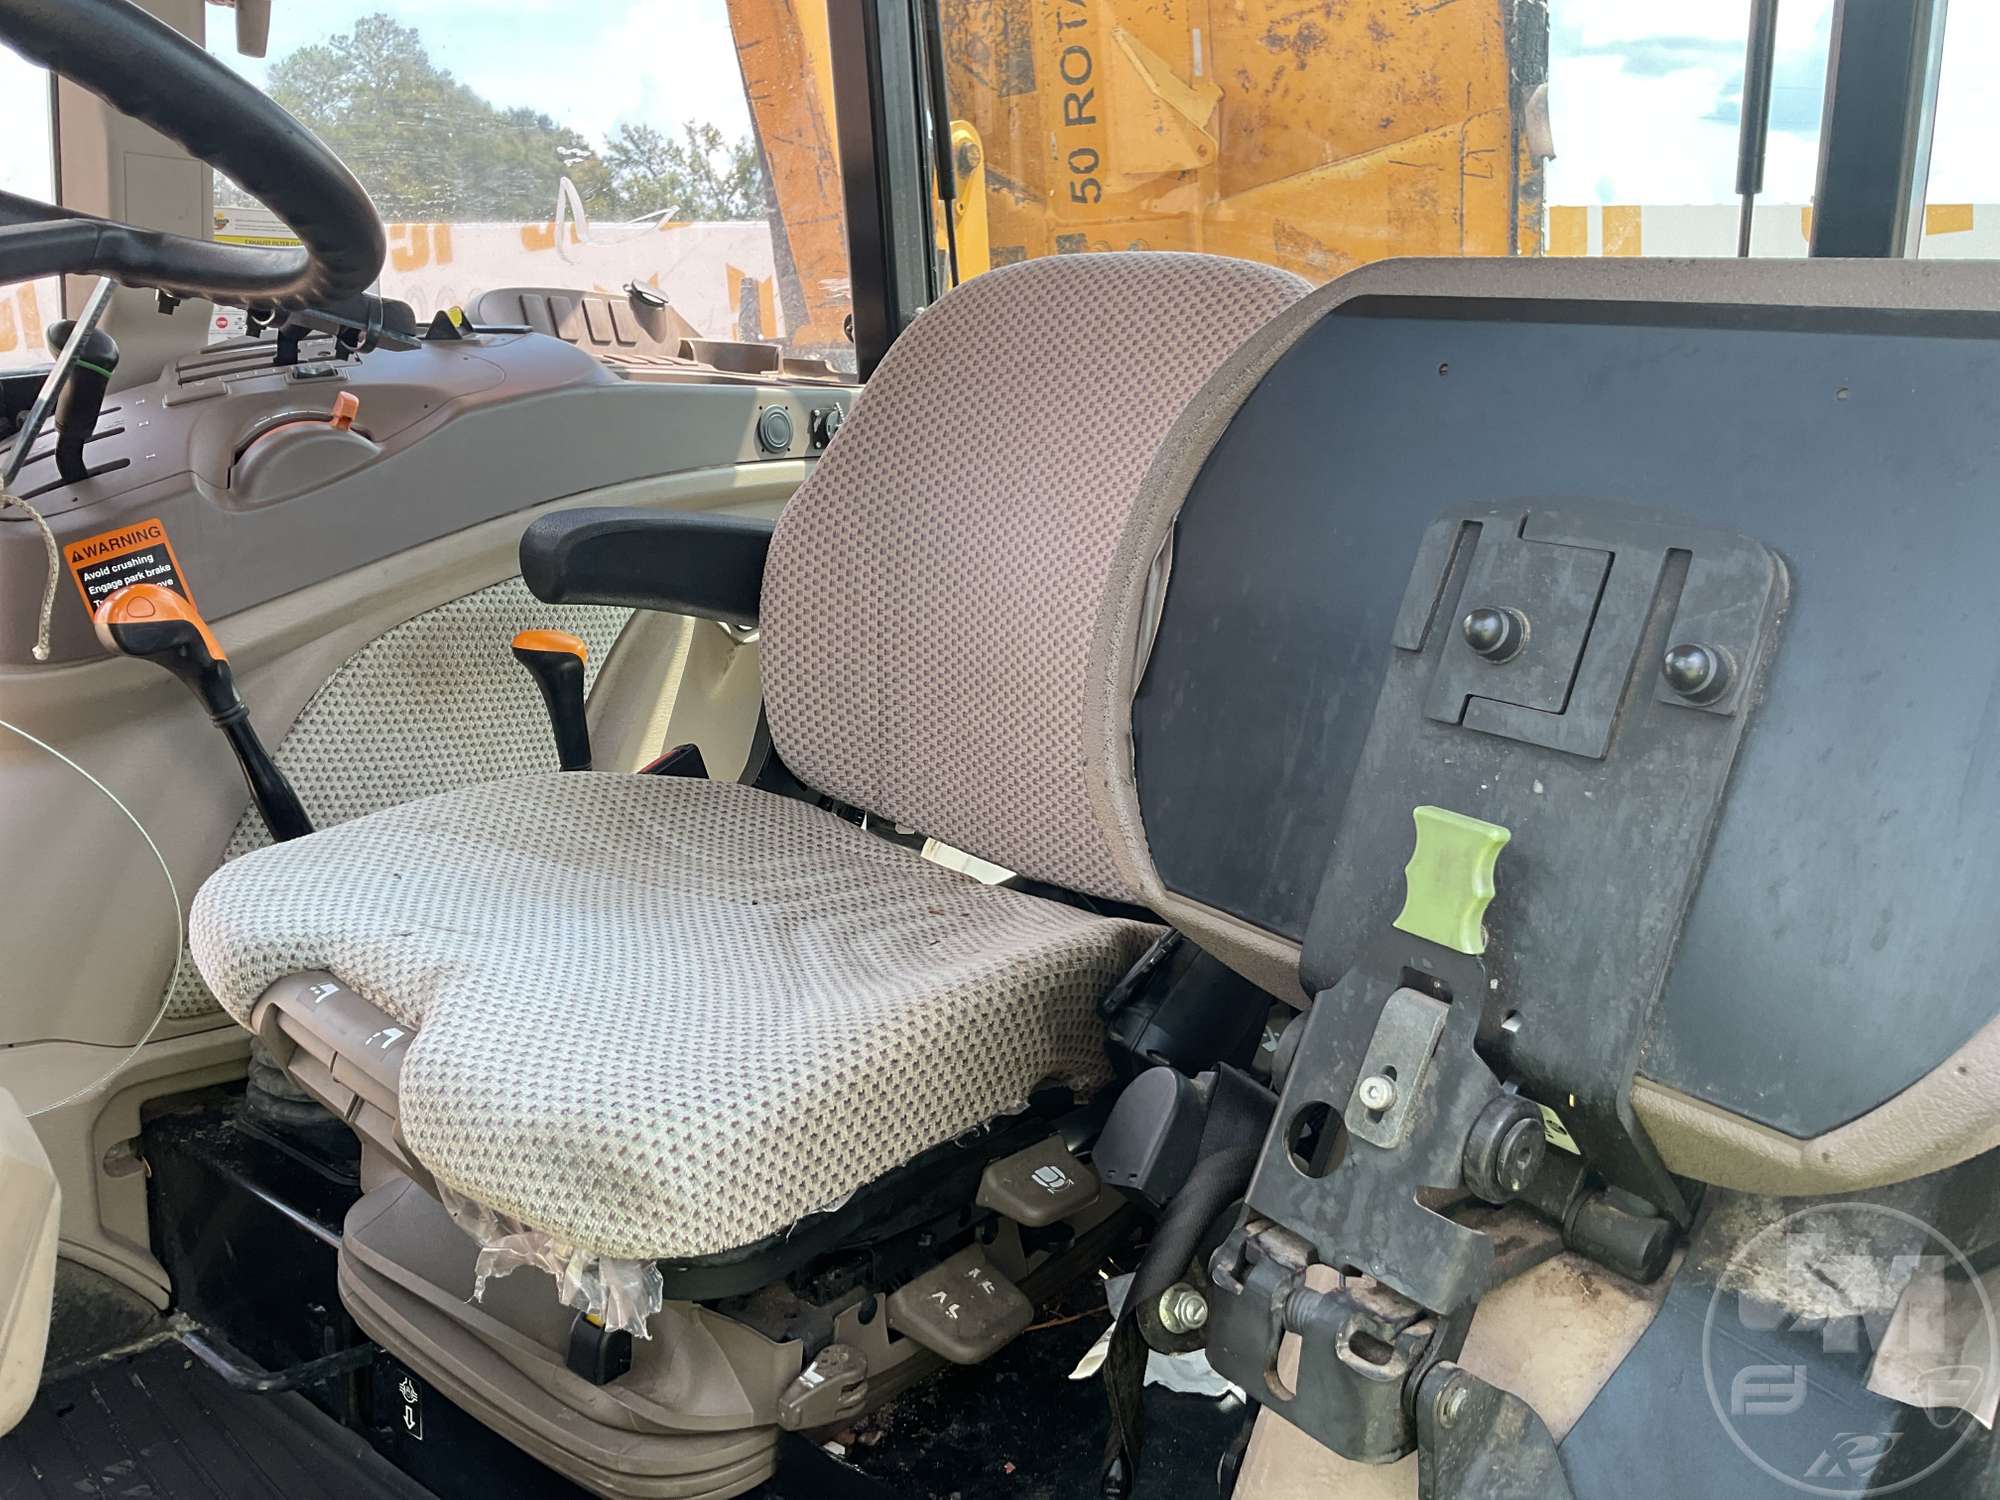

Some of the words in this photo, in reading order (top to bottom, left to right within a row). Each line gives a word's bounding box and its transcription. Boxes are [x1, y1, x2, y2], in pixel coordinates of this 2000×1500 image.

[1069, 148, 1101, 204] 50
[82, 526, 161, 558] WARNING
[84, 566, 110, 582] Avoid
[111, 554, 154, 573] crushing
[88, 579, 123, 595] Engage
[124, 572, 146, 586] park
[146, 563, 171, 578] brake
